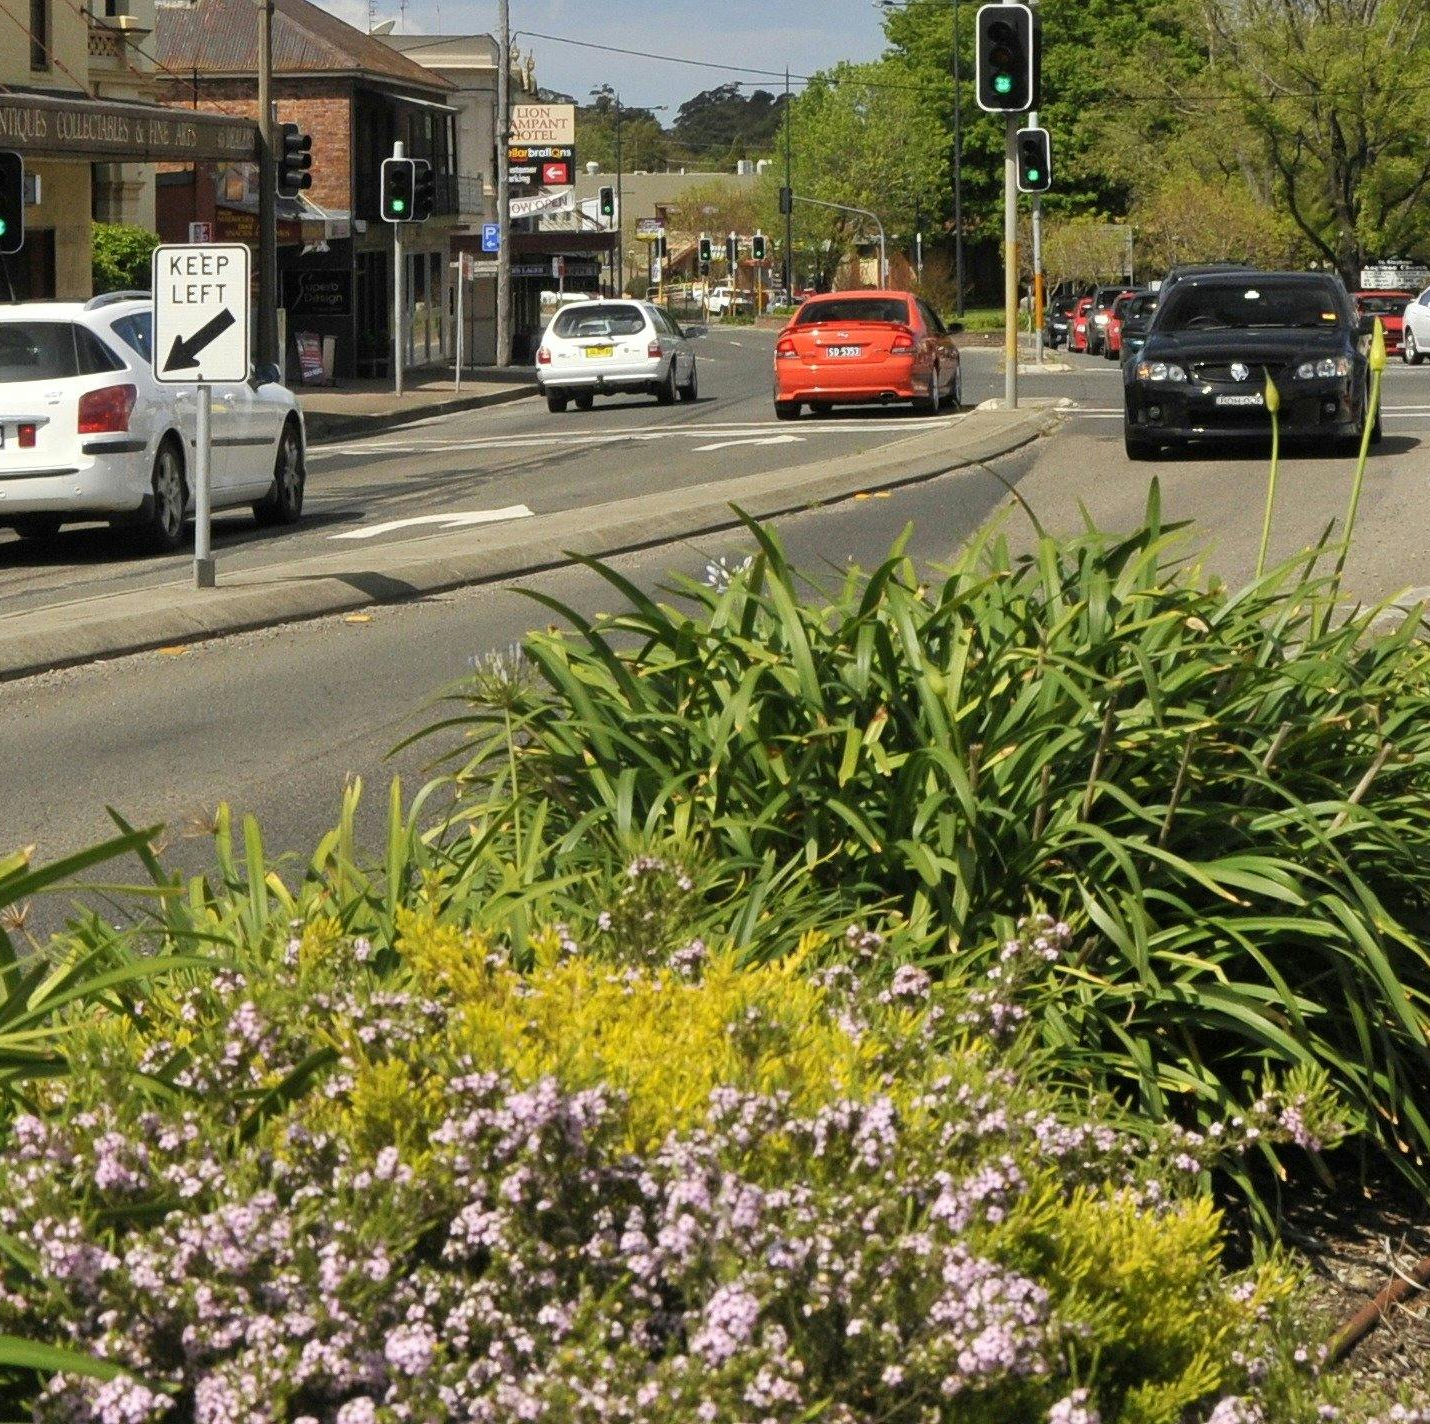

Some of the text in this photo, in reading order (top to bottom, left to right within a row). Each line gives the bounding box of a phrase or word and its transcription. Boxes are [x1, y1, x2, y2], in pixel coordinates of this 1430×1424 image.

[517, 107, 551, 118] LION
[56, 110, 129, 143] COLLECTABLES
[135, 123, 145, 143] &
[511, 118, 569, 130] AMPANT
[511, 129, 557, 141] HOTEL
[511, 201, 533, 214] OW
[169, 255, 229, 276] KEEP
[172, 283, 227, 304] LEFT
[304, 293, 343, 306] Design
